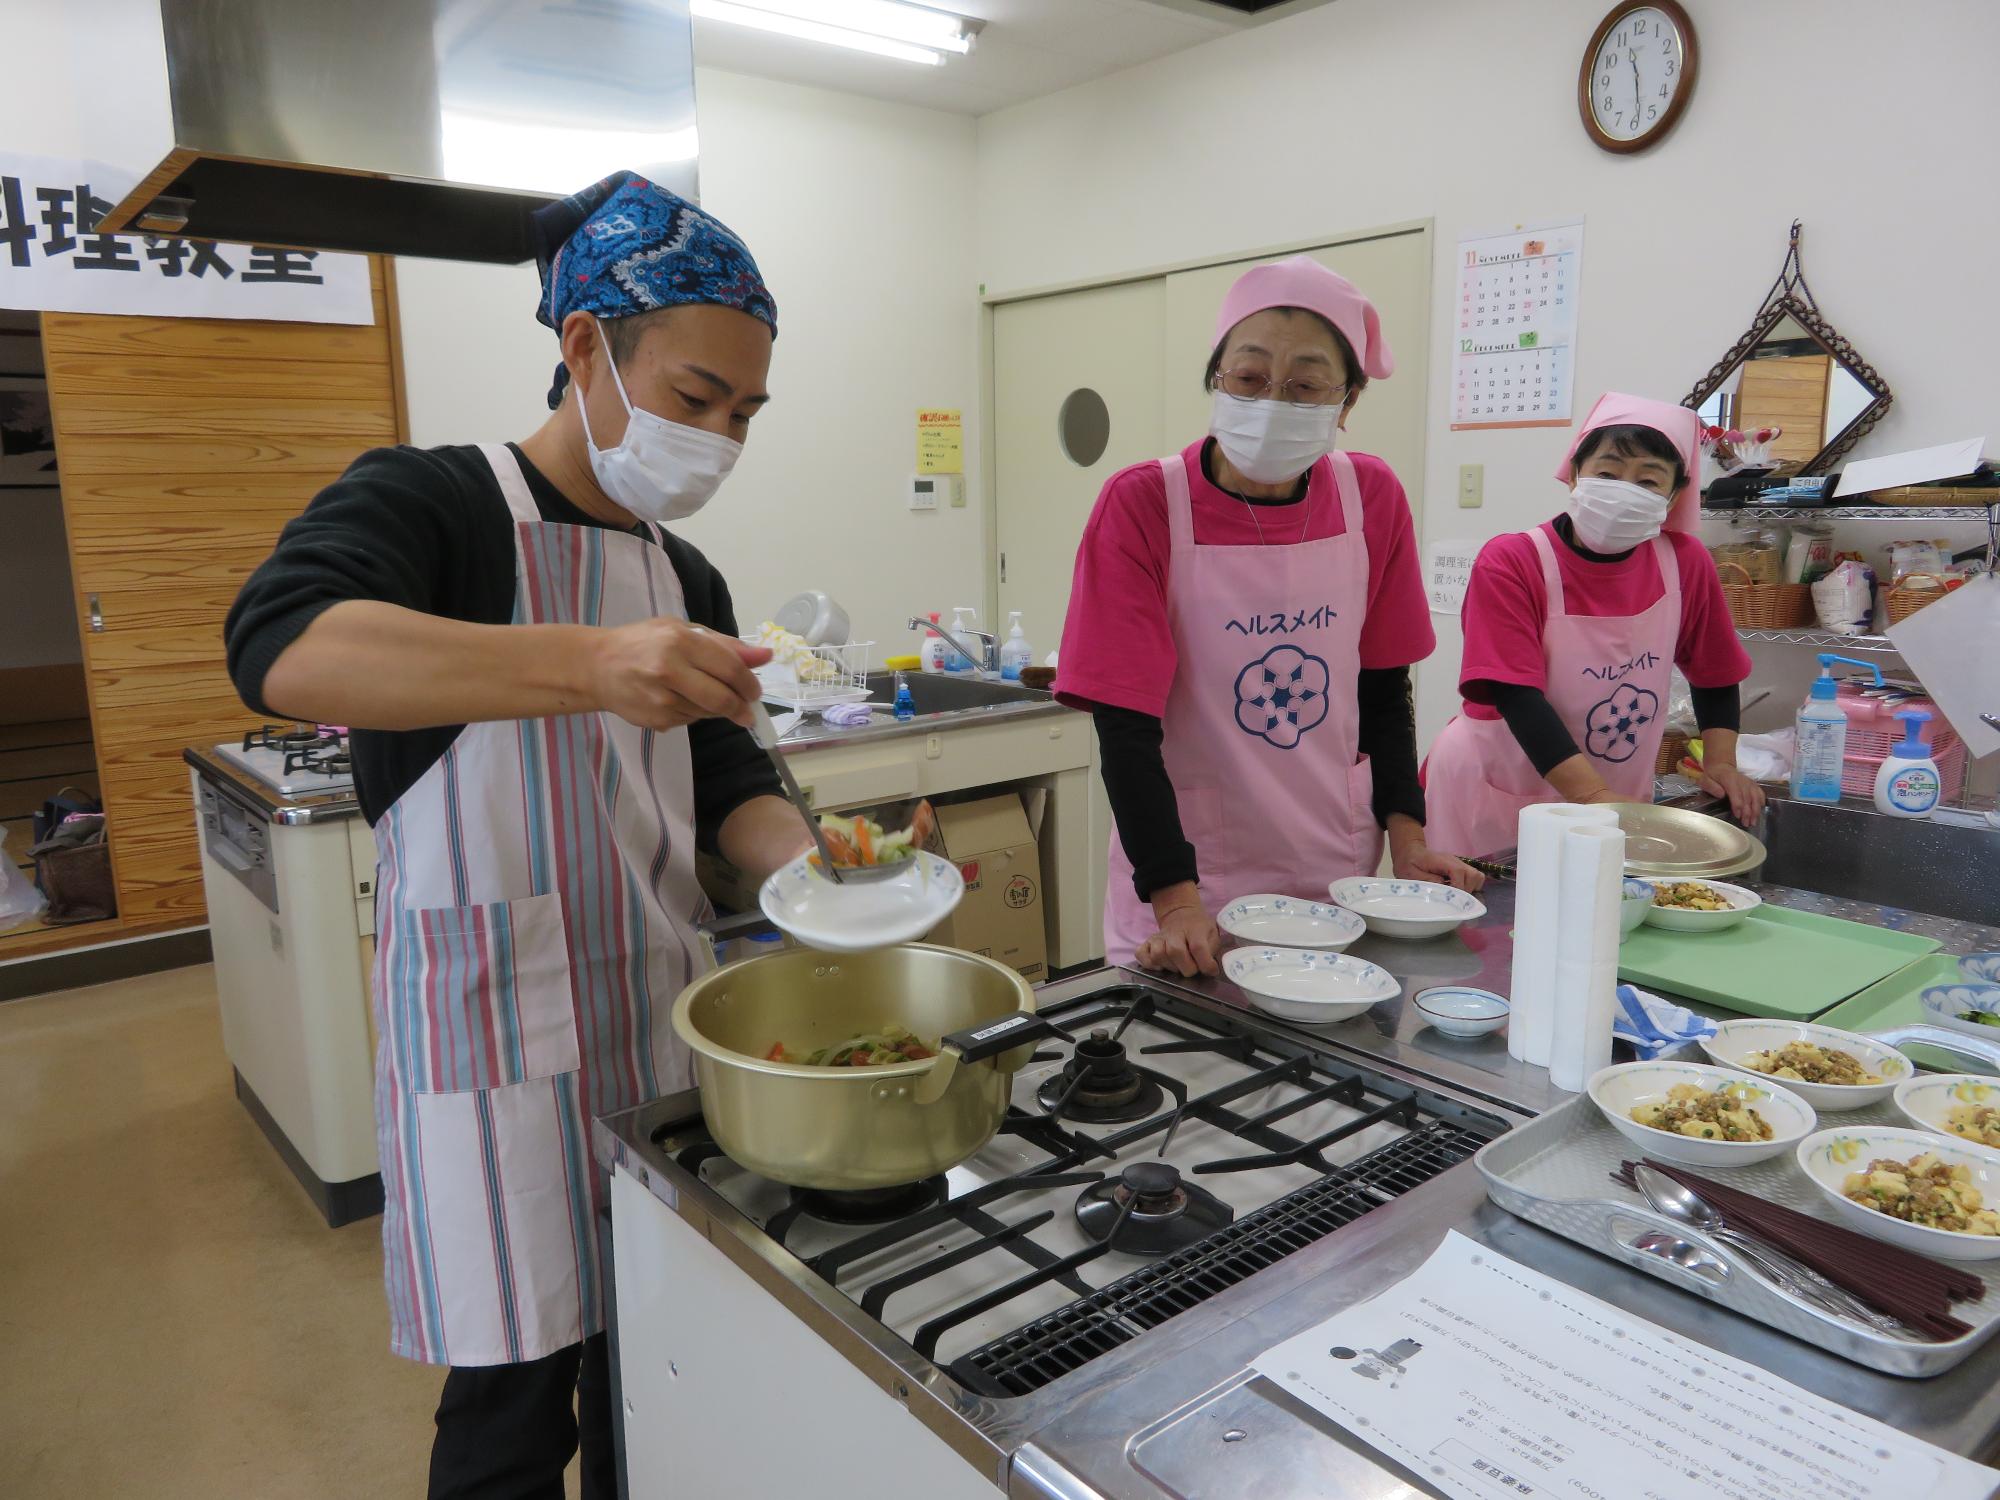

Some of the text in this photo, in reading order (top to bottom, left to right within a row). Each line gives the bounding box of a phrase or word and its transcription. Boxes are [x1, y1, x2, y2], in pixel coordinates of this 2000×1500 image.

[1634, 19, 1646, 36] 12
[1656, 24, 1659, 38] 1
[1617, 32, 1627, 47] 11
[1662, 39, 1671, 55] 2
[1605, 54, 1617, 69] 10
[1665, 60, 1674, 76] 3
[1602, 75, 1610, 90] 9
[1659, 84, 1668, 98] 4
[1604, 96, 1612, 111] 8
[1615, 112, 1622, 126] 7
[1647, 104, 1656, 120] 5
[1630, 114, 1638, 130] 6
[1466, 251, 1476, 265] 11
[1460, 339, 1473, 352] 12
[1225, 605, 1338, 635] ヘルスメイト
[1498, 1426, 1565, 1464] 麻婆豆腐の素
[1471, 1458, 1533, 1497] 麻婆豆腐
